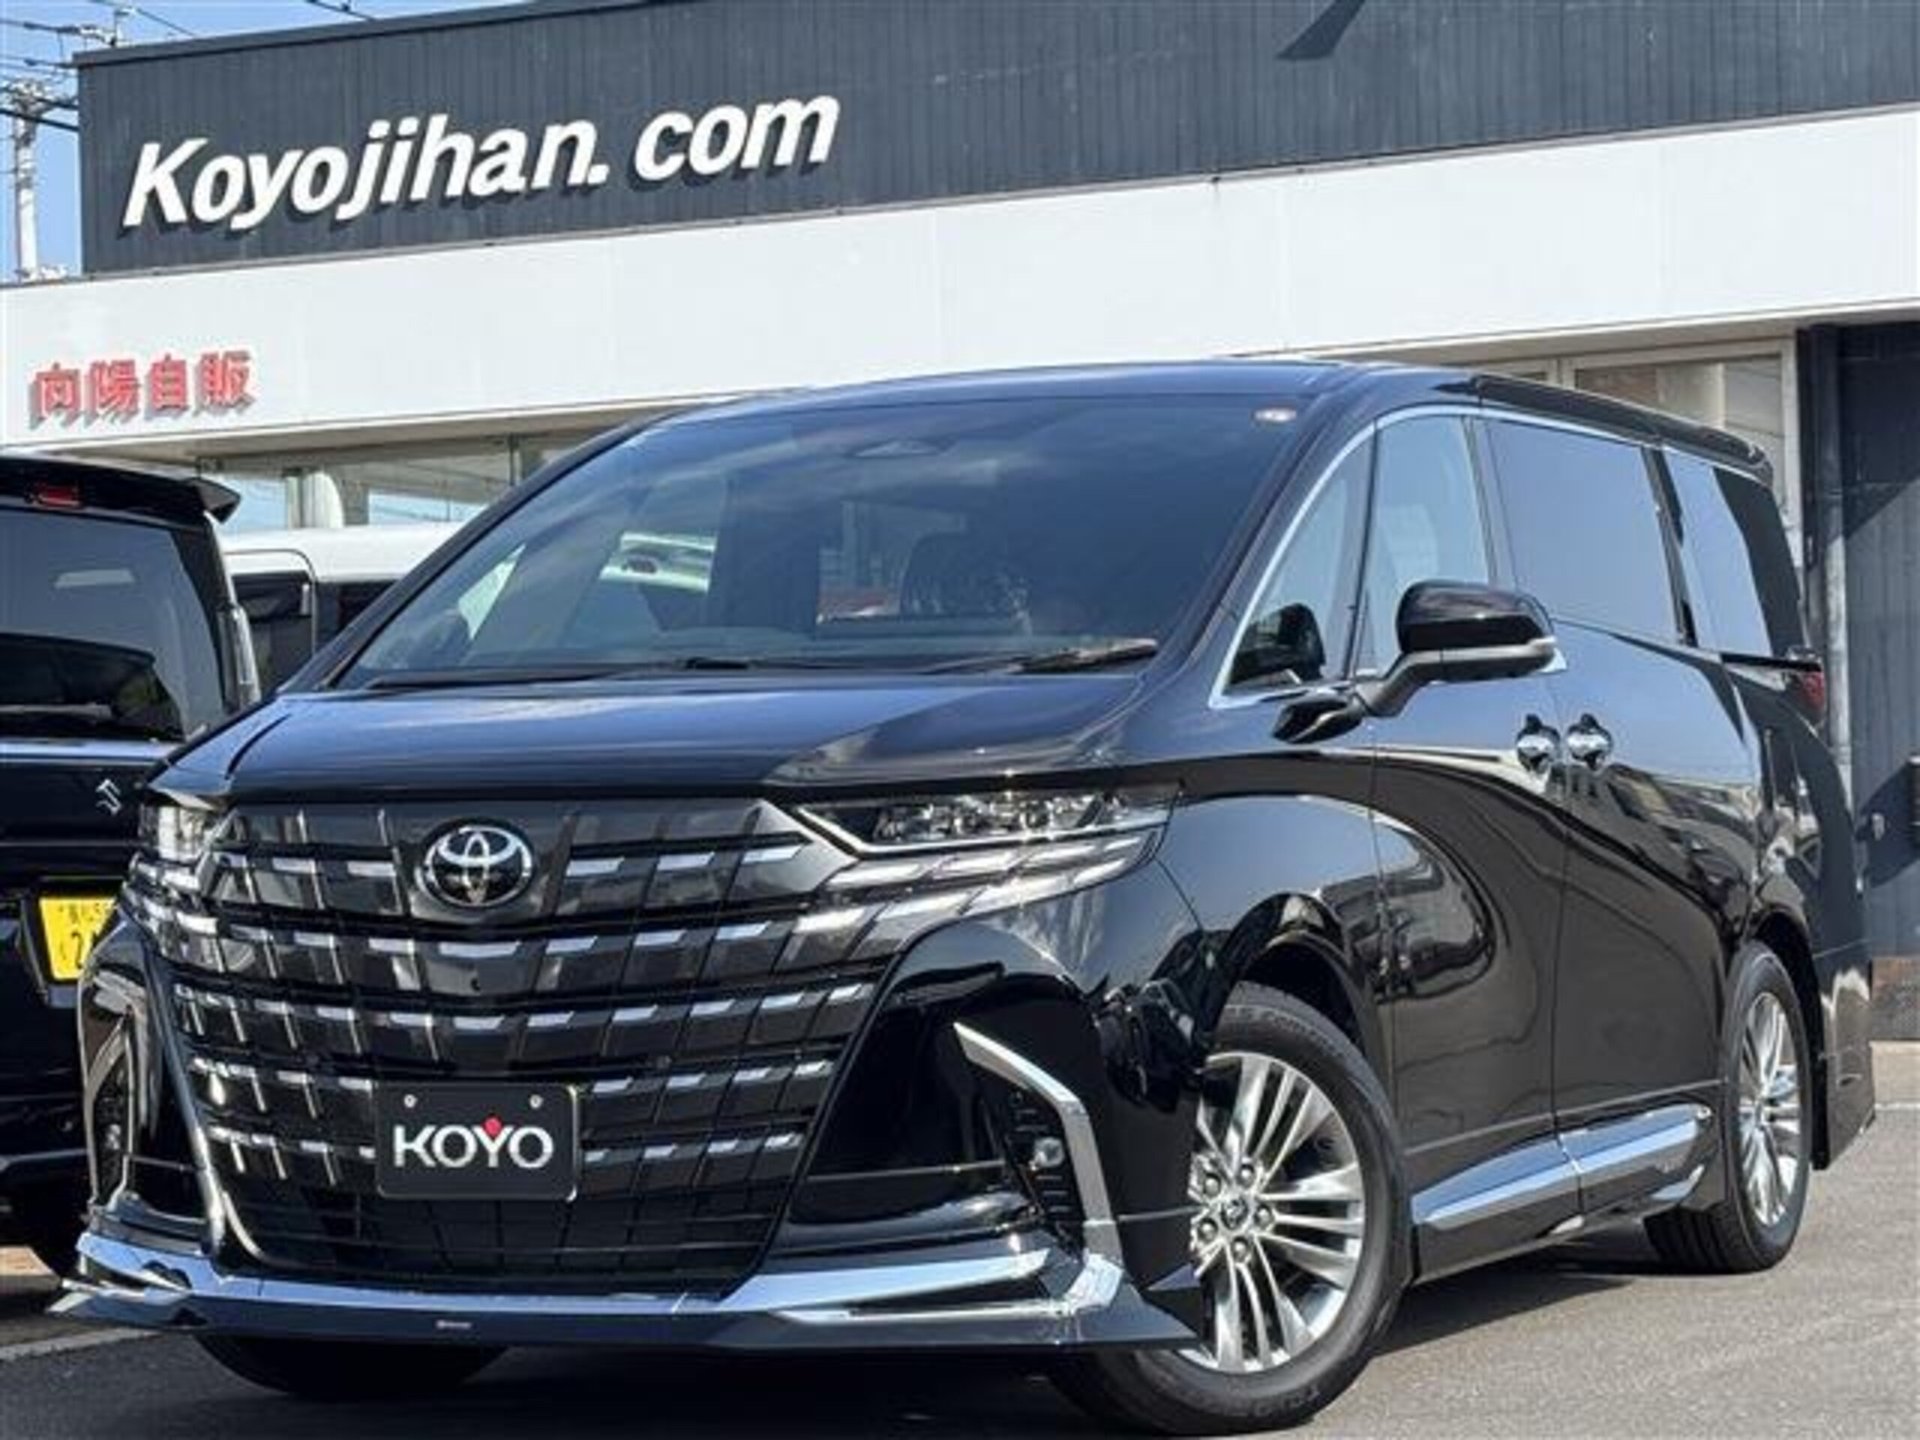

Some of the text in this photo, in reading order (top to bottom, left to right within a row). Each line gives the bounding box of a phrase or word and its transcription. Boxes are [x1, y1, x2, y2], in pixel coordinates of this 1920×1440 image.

[34, 352, 252, 422] 向陽自販
[393, 1124, 553, 1168] KOYO
